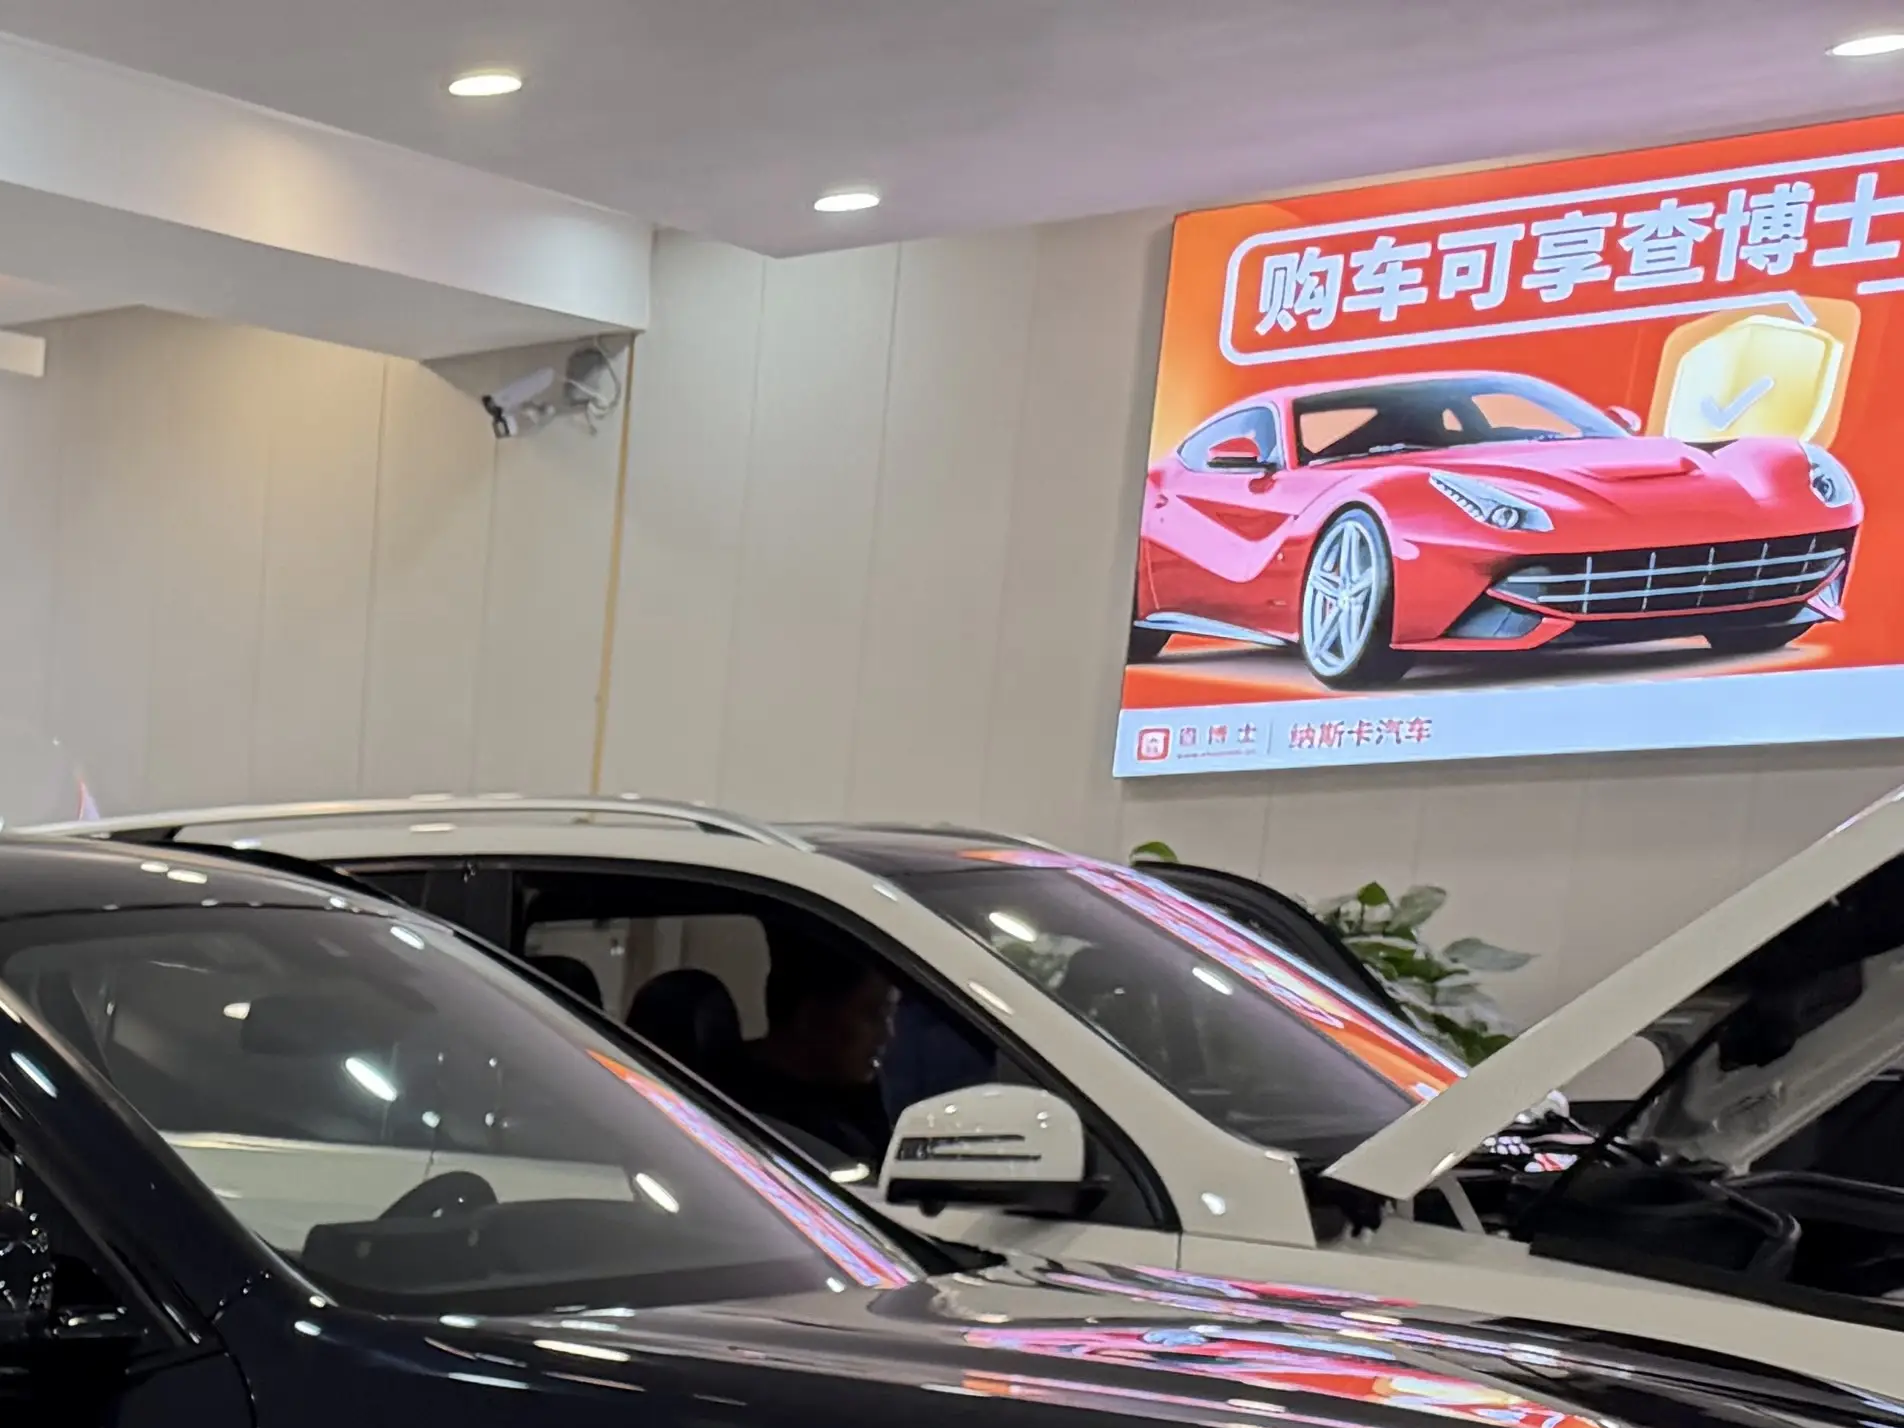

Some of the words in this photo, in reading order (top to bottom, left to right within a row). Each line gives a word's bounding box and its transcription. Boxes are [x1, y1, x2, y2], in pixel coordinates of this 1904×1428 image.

[1255, 171, 1904, 336] 购车可享查博士
[1289, 716, 1432, 748] 纳斯卡汽车
